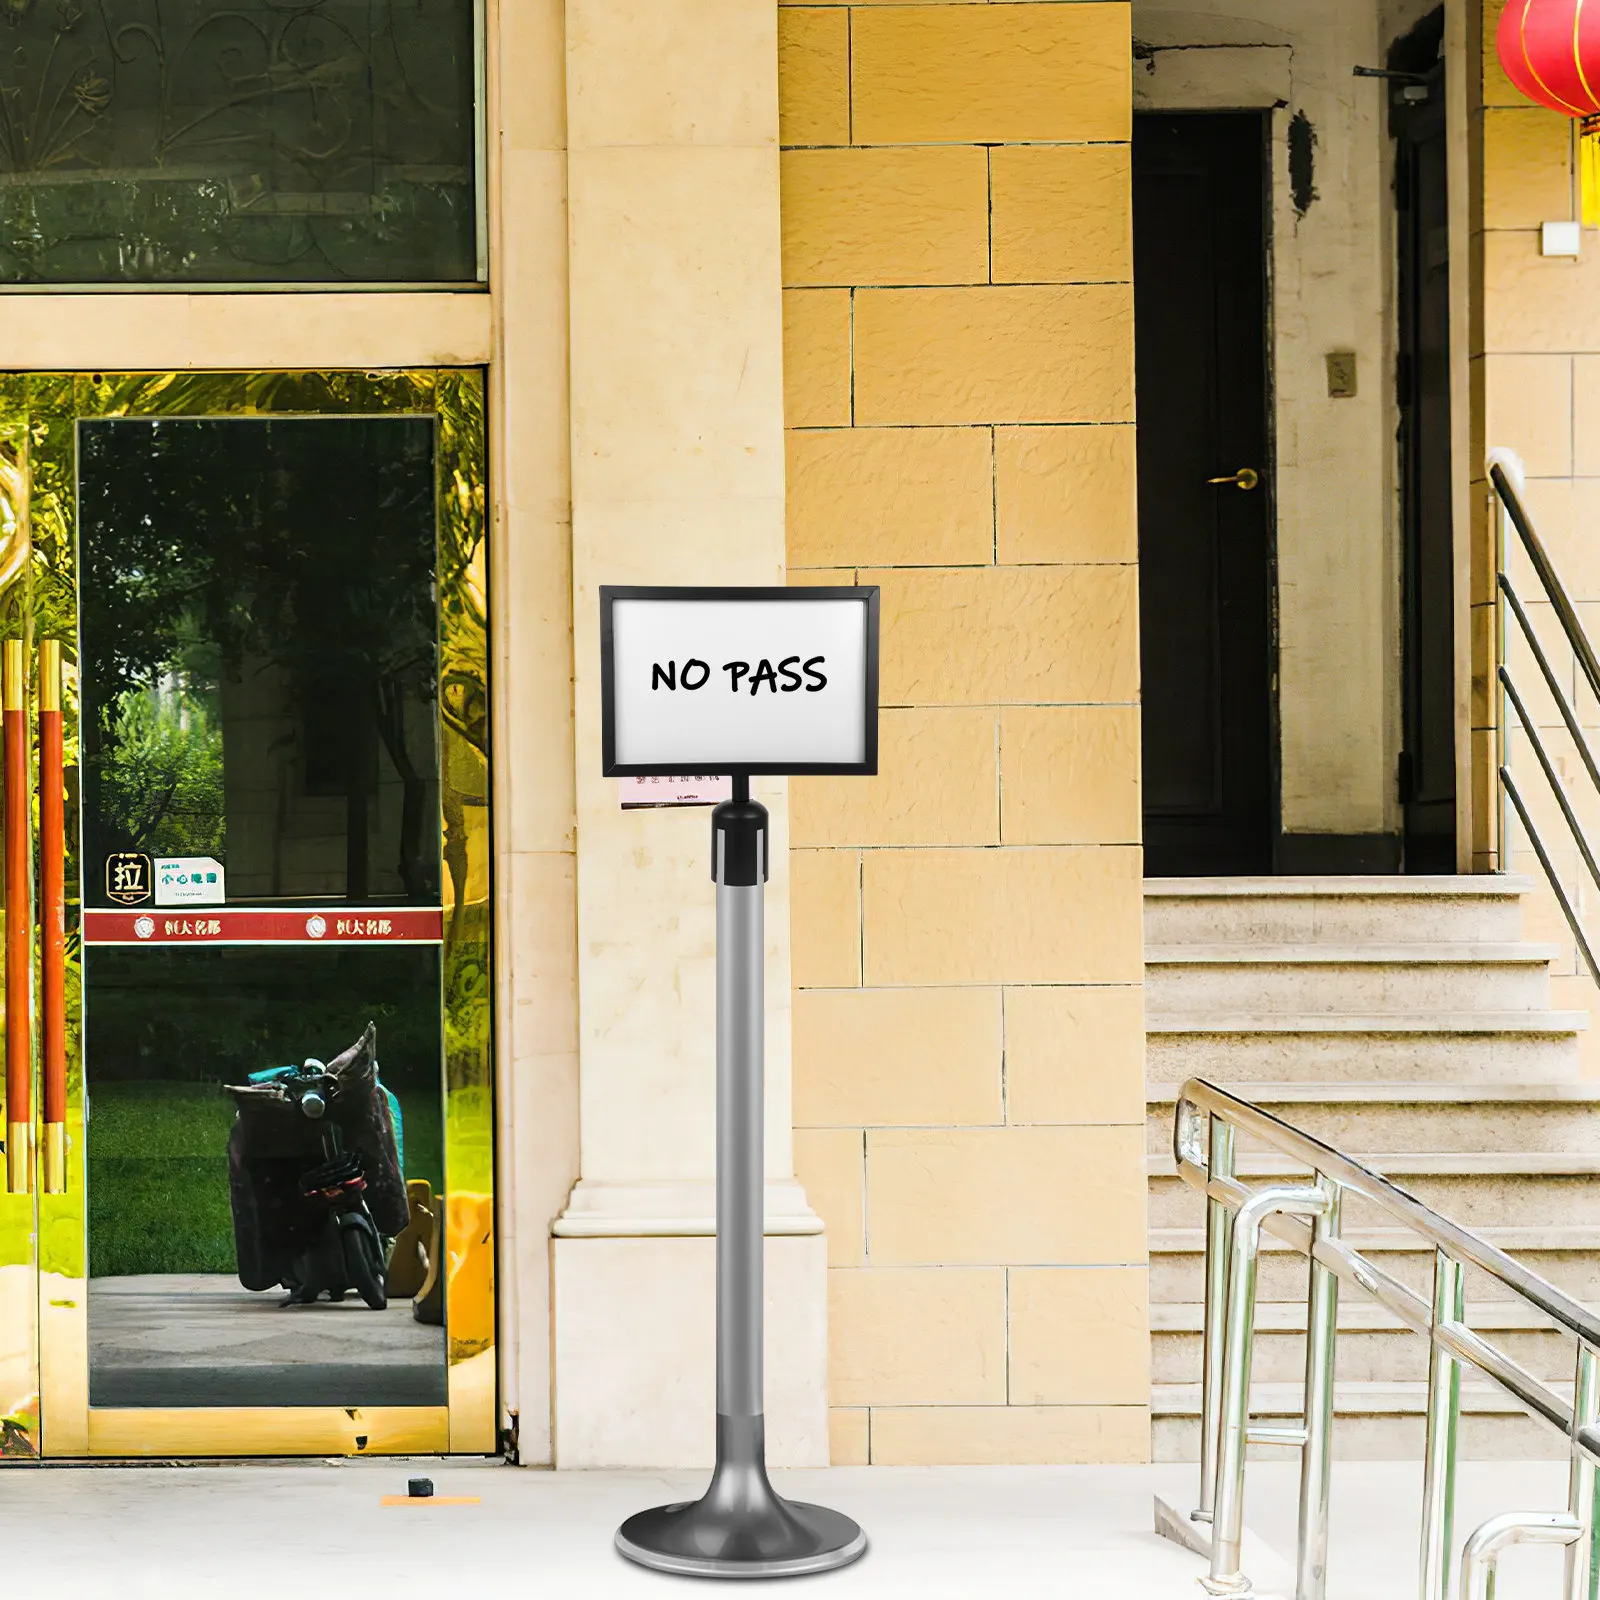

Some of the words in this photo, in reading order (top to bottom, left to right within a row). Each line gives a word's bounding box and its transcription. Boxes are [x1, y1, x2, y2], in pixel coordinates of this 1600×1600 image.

[651, 658, 711, 691] NO
[722, 655, 828, 697] PASS
[114, 862, 144, 891] 拉
